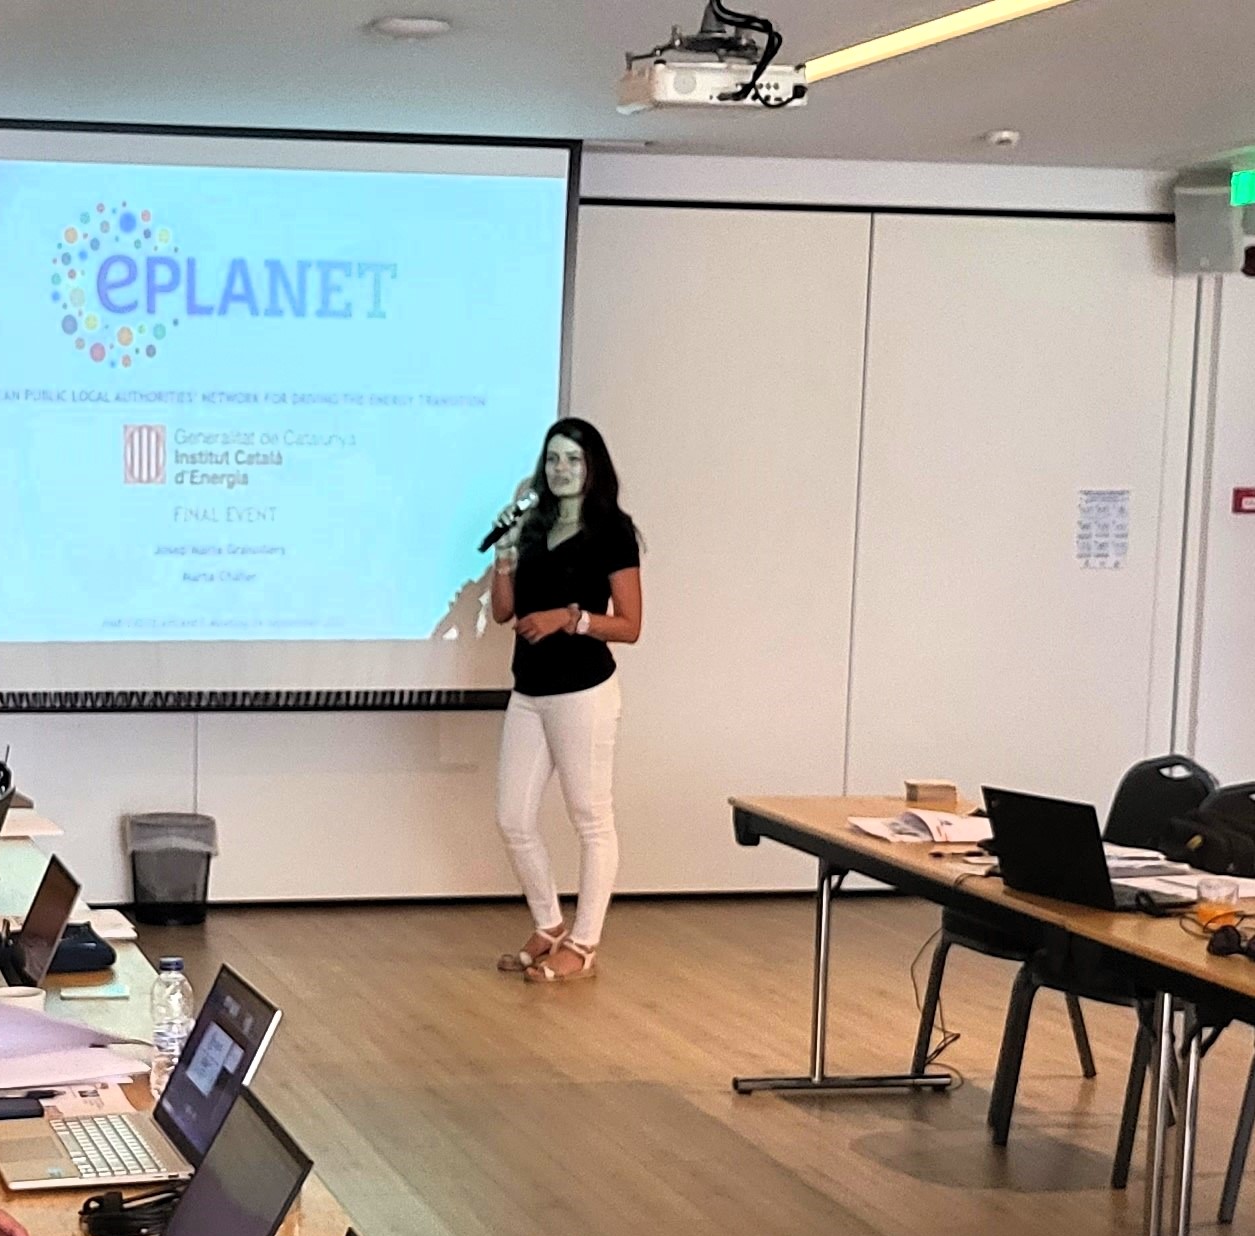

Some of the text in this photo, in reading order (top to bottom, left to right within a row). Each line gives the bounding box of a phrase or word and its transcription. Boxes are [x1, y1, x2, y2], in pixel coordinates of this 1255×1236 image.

[96, 254, 397, 318] ePLANET
[25, 388, 66, 401] PUBLIC
[71, 389, 110, 402] LOCAL
[174, 449, 283, 465] Institut Català
[174, 506, 277, 523] FINAL EVENT
